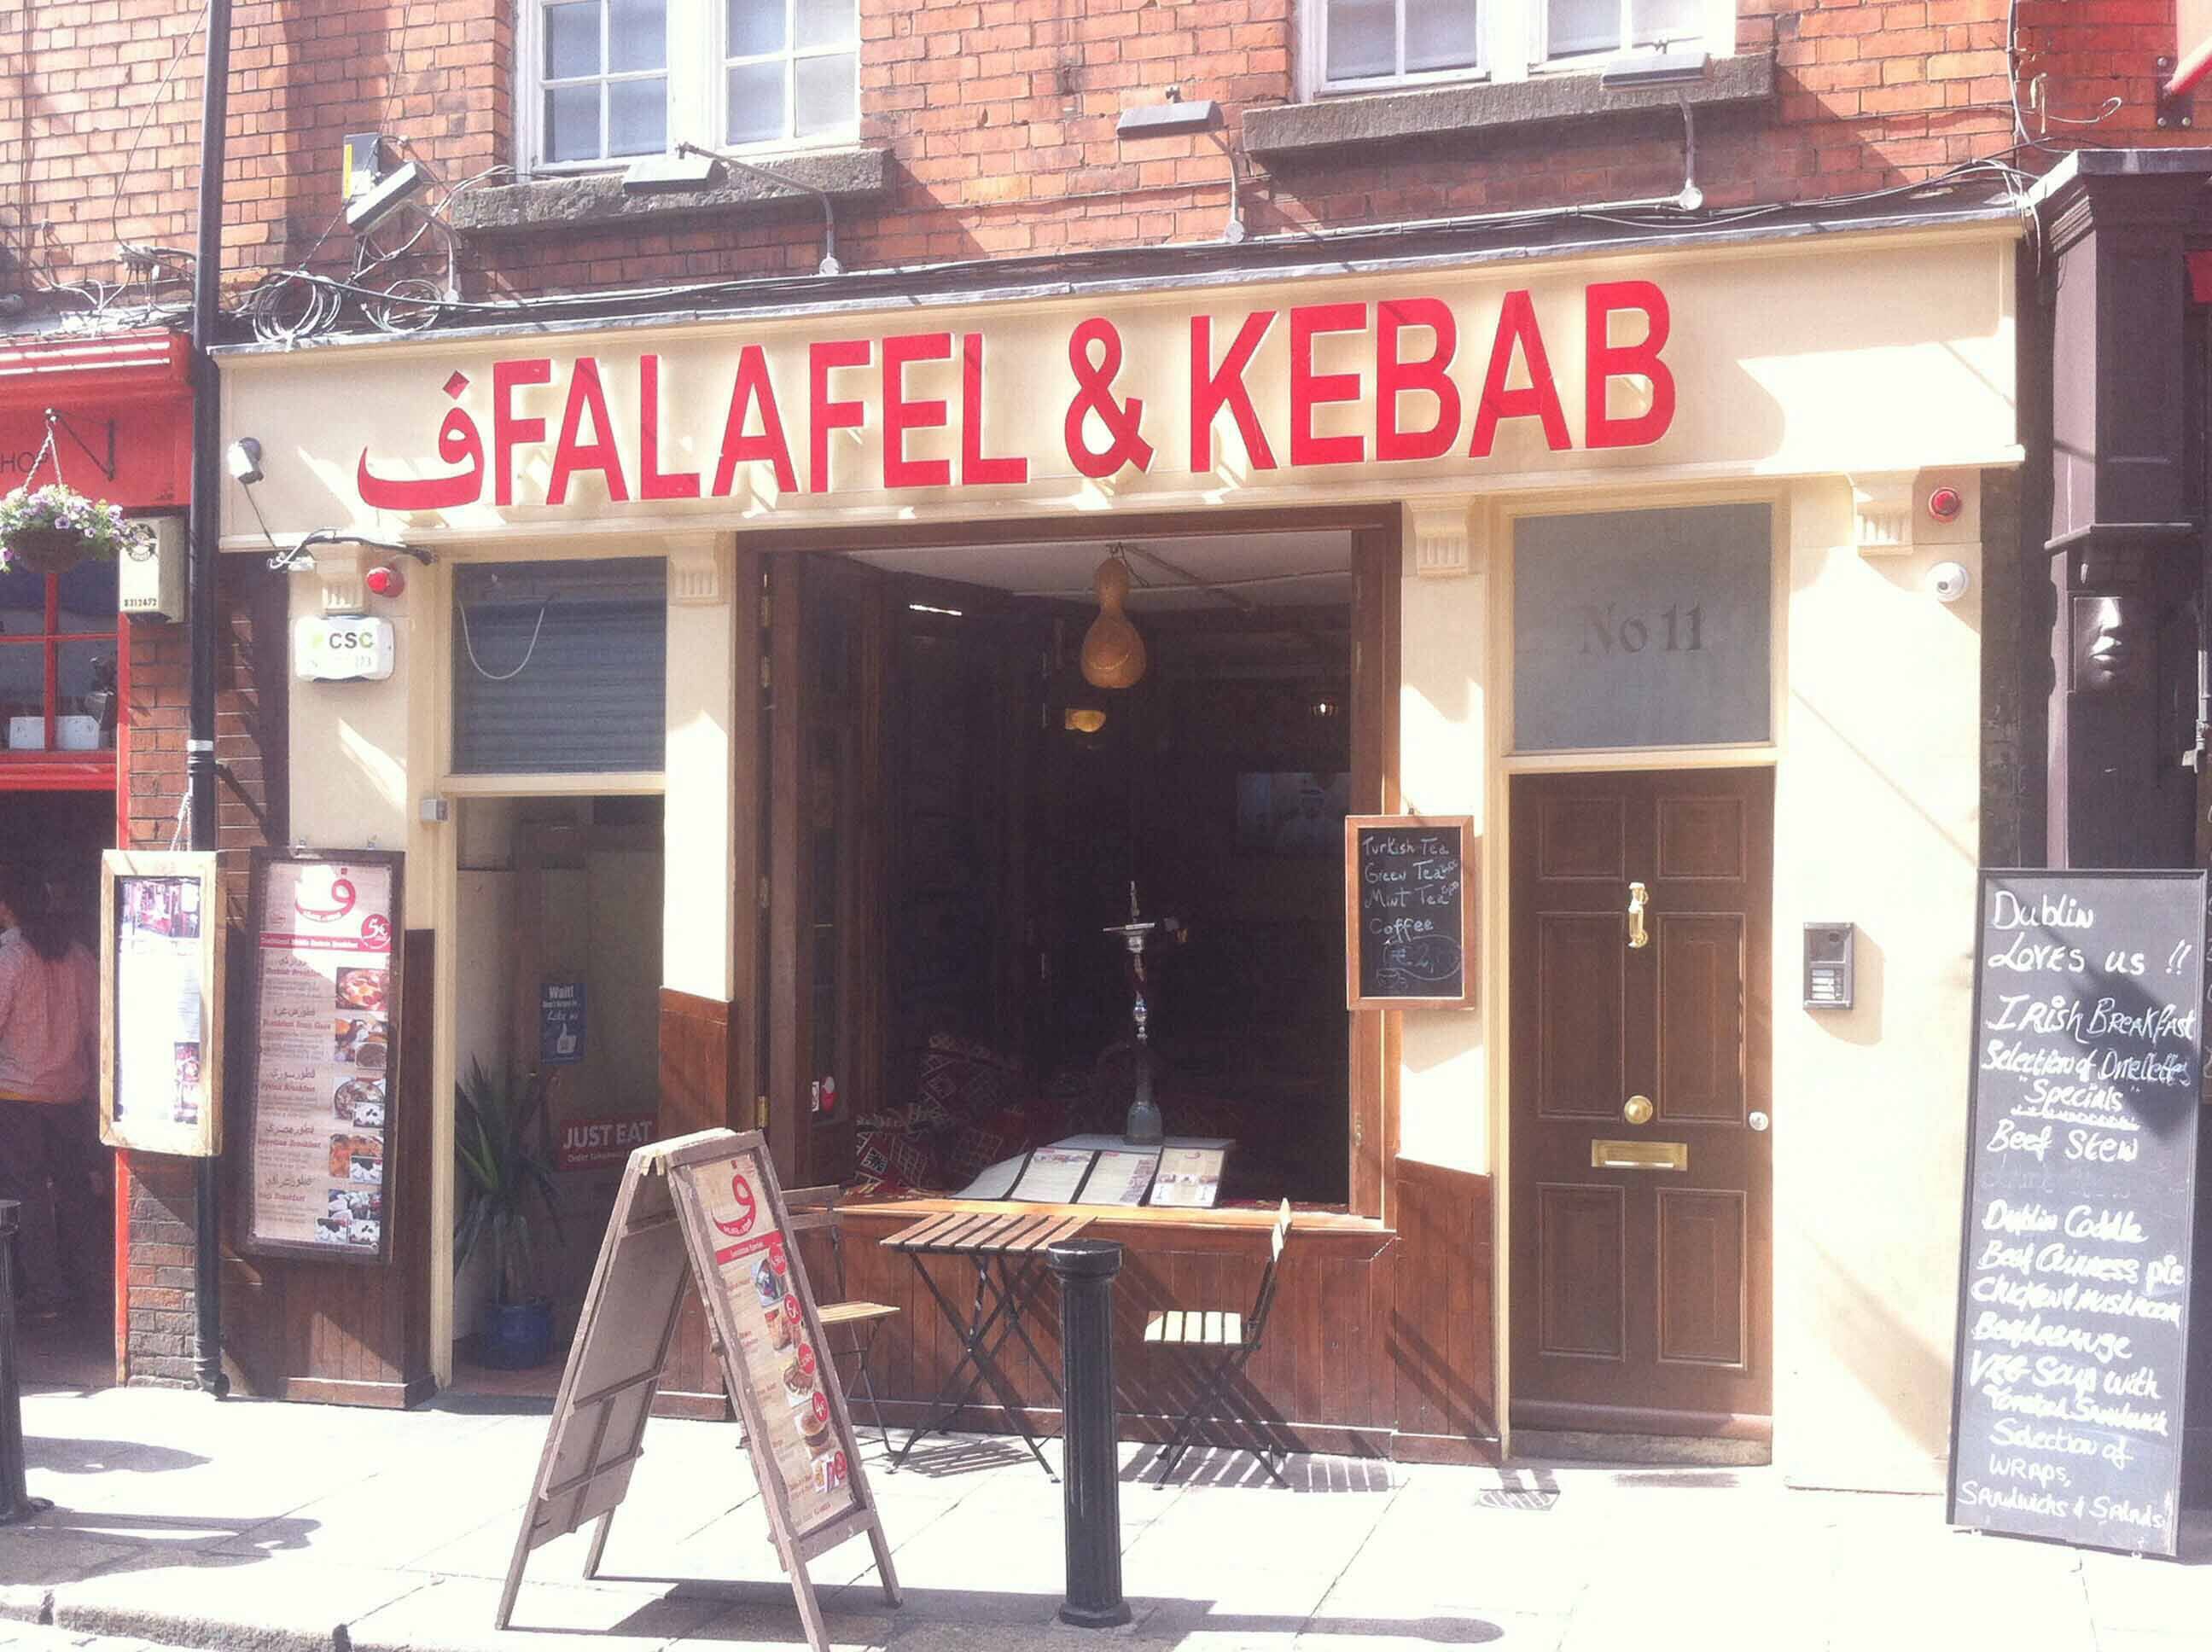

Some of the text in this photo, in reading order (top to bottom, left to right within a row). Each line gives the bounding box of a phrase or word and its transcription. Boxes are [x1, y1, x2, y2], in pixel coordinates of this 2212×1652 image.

[492, 280, 1676, 507] FALAFEL & KEBAB
[329, 631, 374, 649] CSC
[1577, 600, 1707, 654] No 11
[1361, 836, 1449, 856] Turkish Tea
[1365, 862, 1406, 884] Green
[1412, 859, 1446, 881] Tea
[1365, 883, 1450, 908] Mint Tea
[1993, 890, 2094, 929] Dublin
[1369, 917, 1435, 943] Coffee
[2104, 950, 2145, 975] us
[563, 1120, 653, 1149] JUST EAT
[1986, 1118, 2138, 1162] Beef Stew
[2064, 1204, 2150, 1243] Coddle
[2103, 1366, 2163, 1399] with
[2102, 1434, 2135, 1470] of
